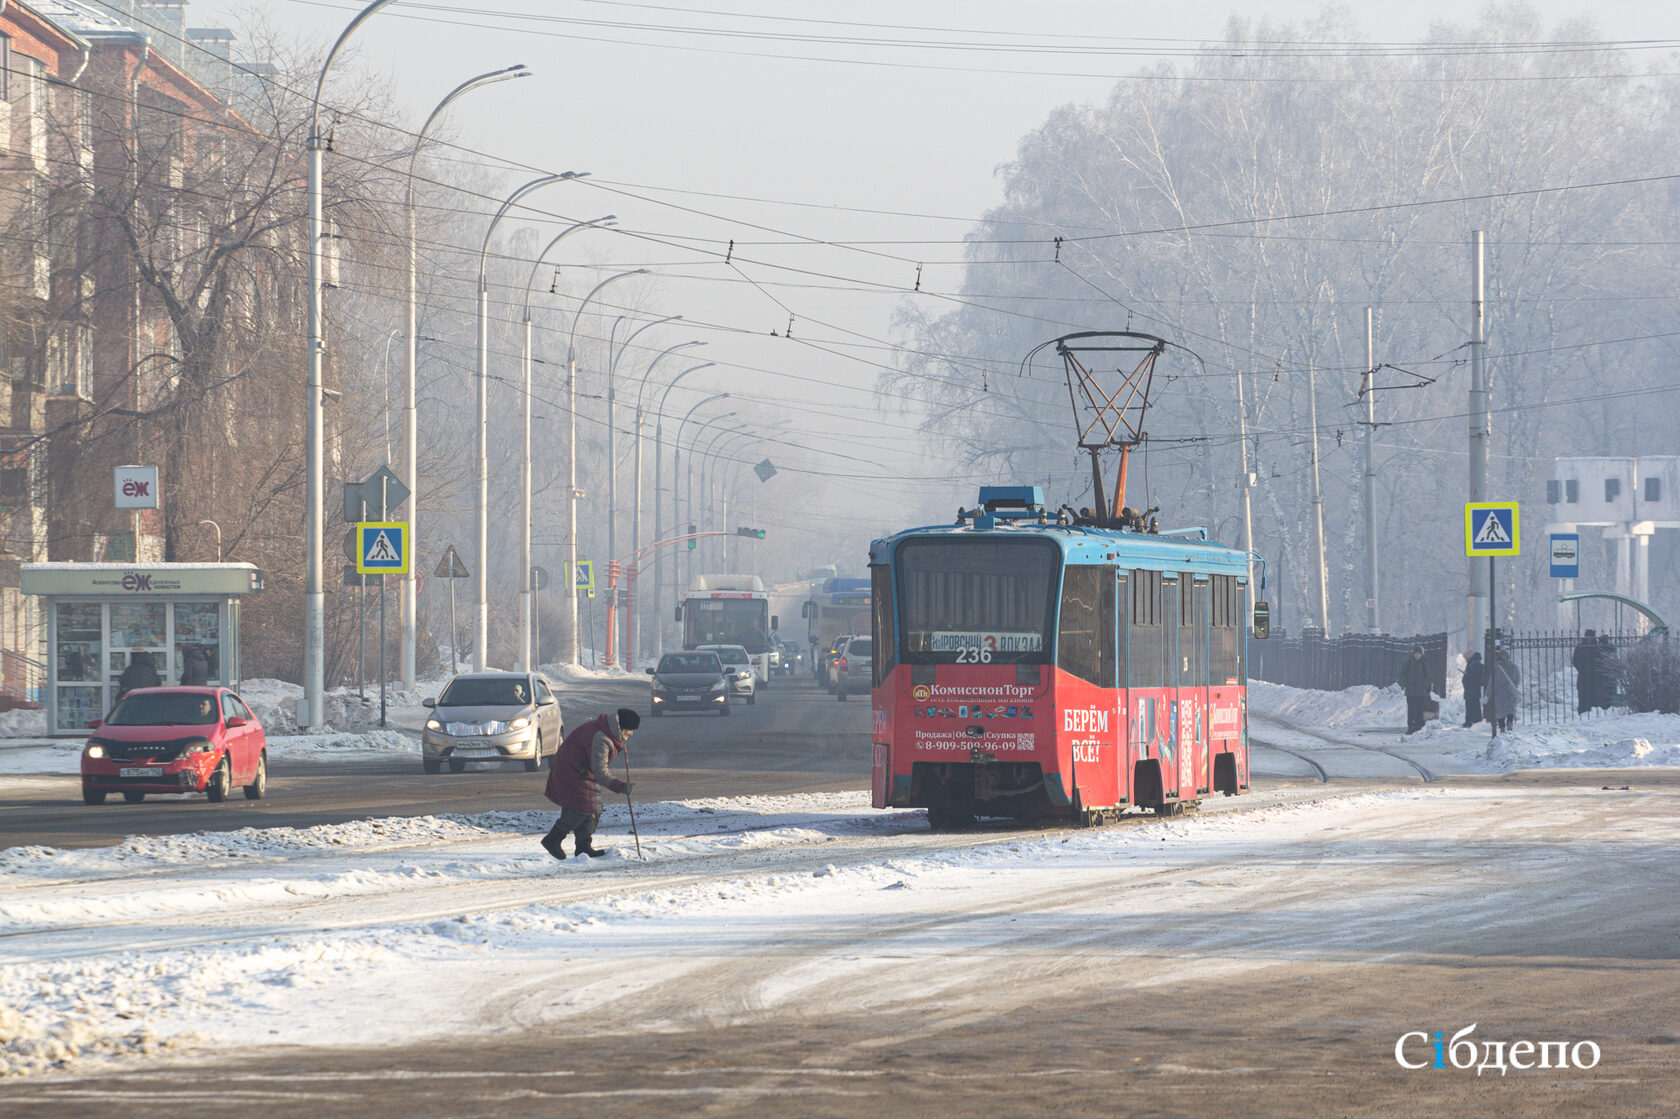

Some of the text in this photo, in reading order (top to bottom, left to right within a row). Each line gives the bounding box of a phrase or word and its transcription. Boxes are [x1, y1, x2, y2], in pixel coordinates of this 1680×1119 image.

[956, 647, 992, 663] 236
[930, 684, 1035, 698] КомиссионТорг
[1064, 704, 1109, 733] БЕРЁМ
[925, 741, 1016, 750] 8-909-509-96-09
[1072, 734, 1100, 763] ВСЁ!
